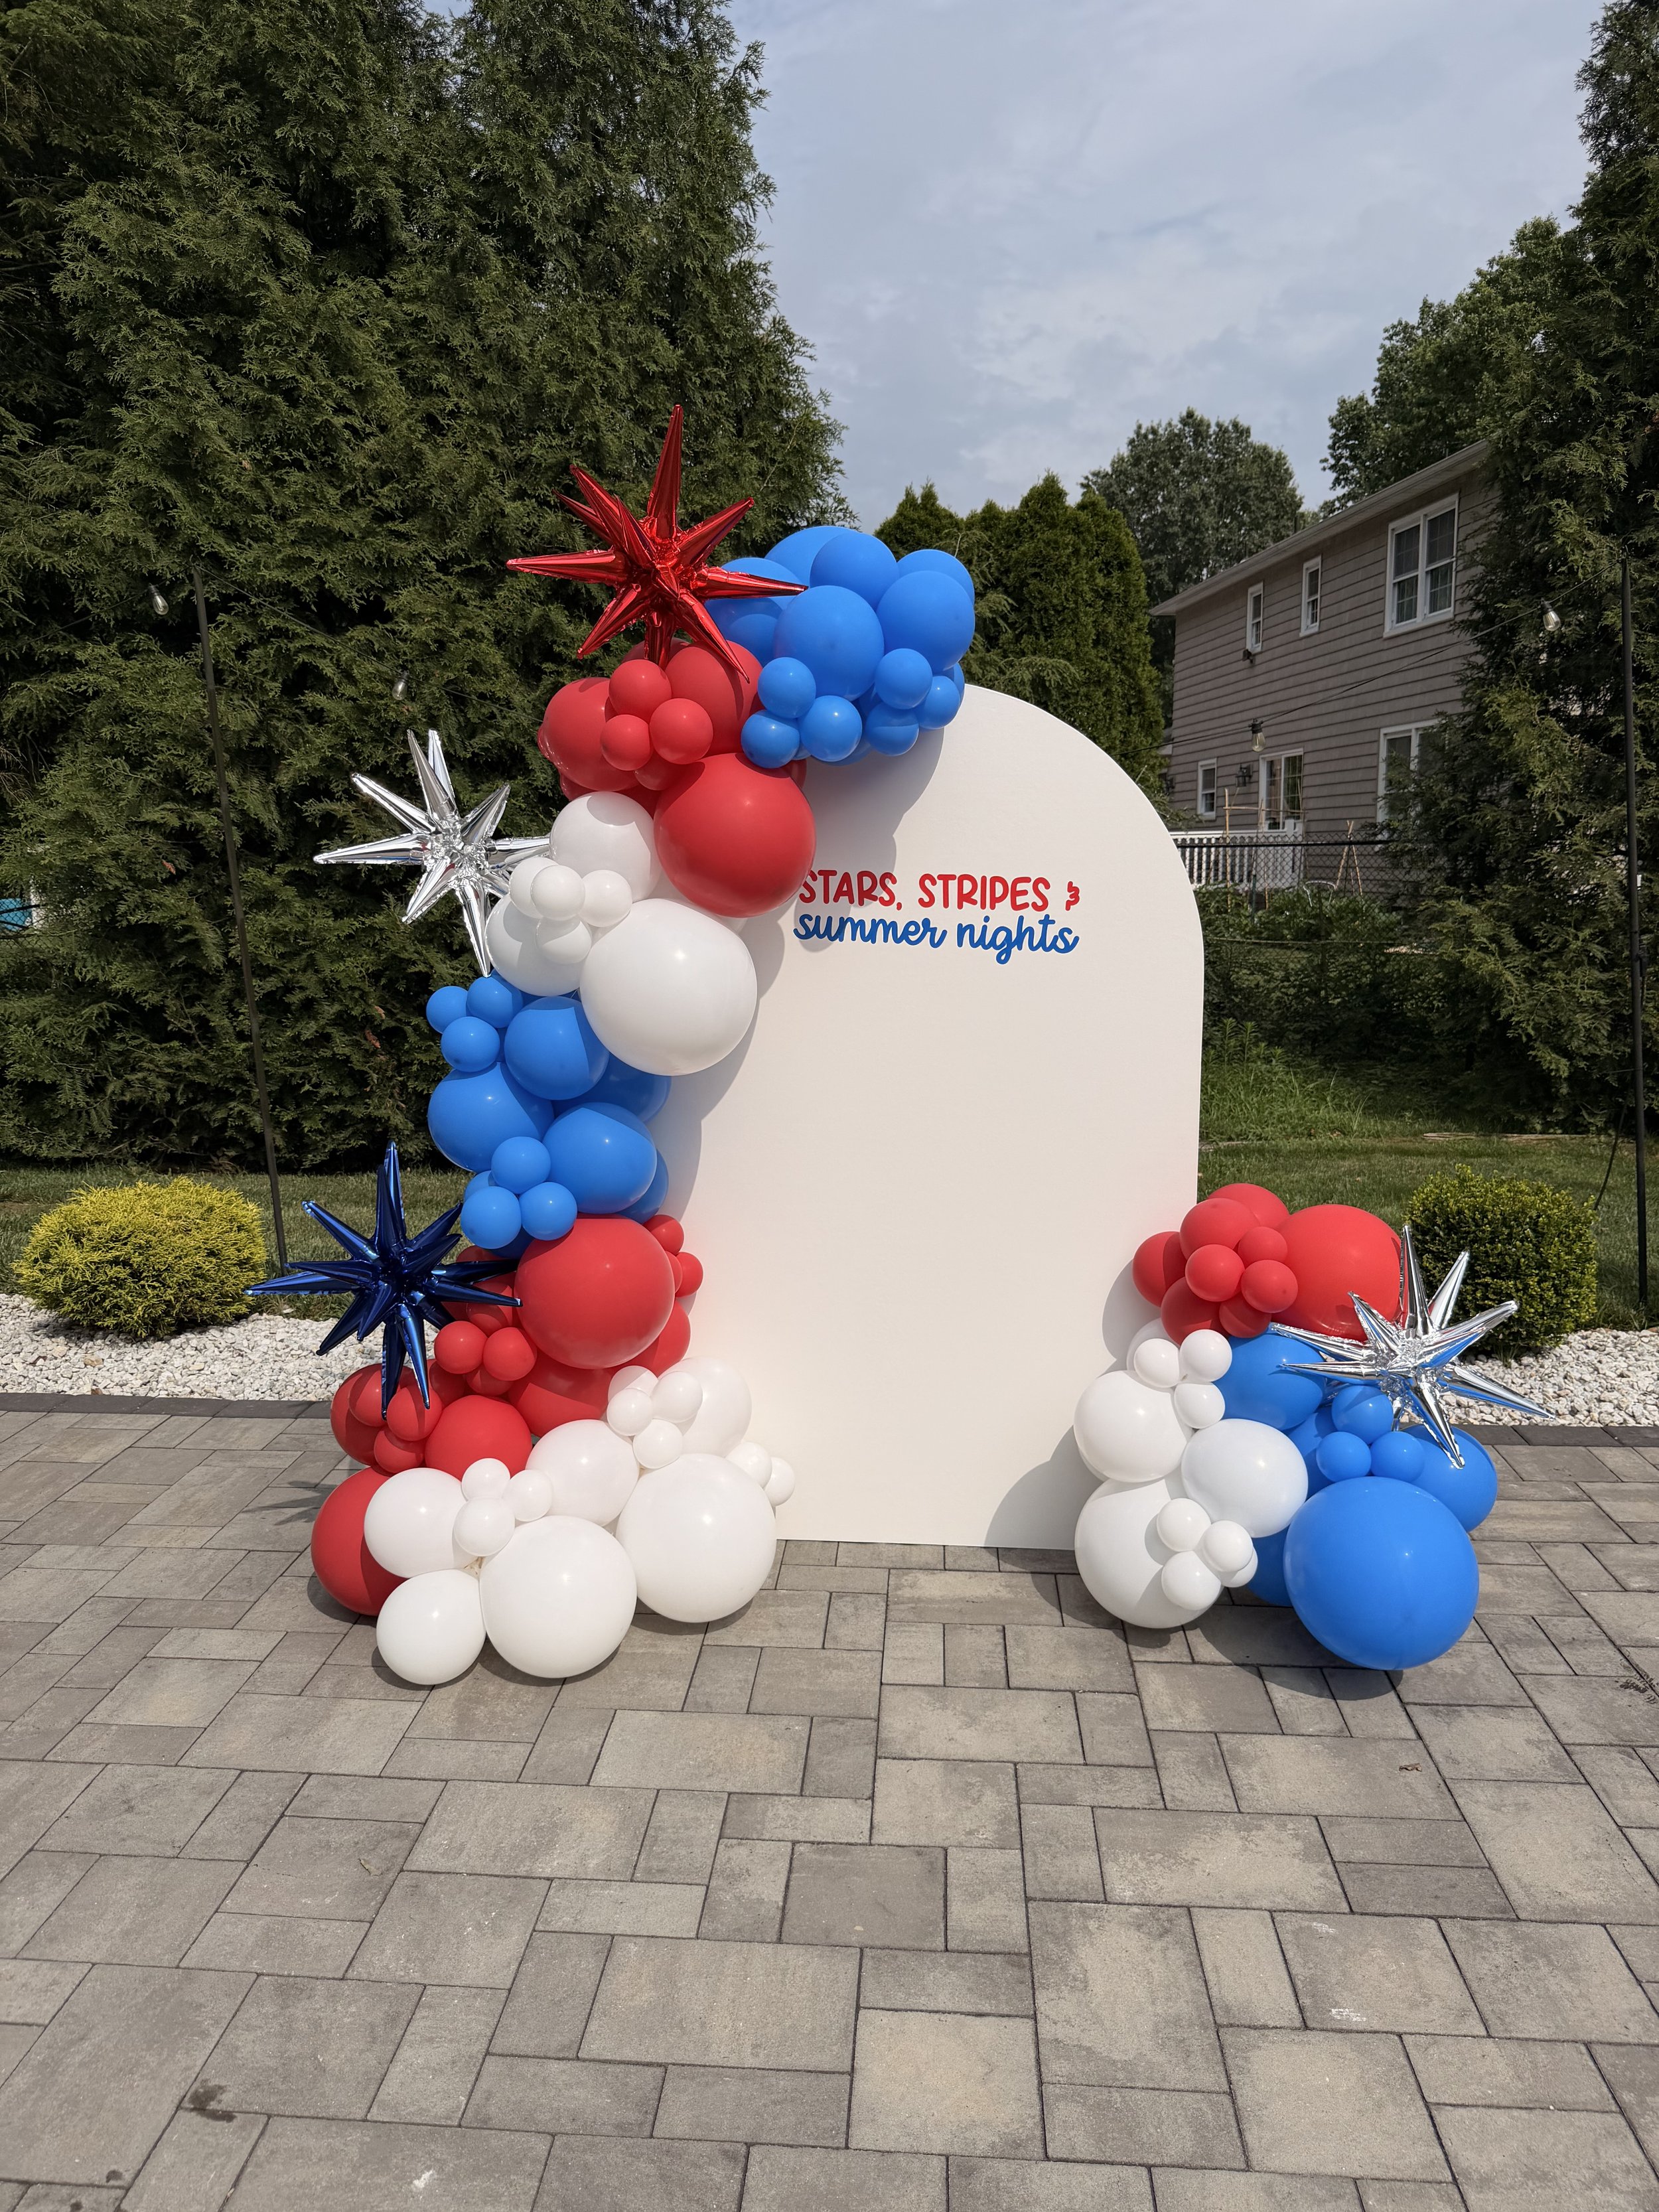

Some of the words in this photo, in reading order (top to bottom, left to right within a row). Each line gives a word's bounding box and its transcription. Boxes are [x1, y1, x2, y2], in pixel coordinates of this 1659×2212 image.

[798, 869, 902, 911] STARS,
[918, 873, 1050, 912] STRIPES
[793, 914, 948, 948] summer
[956, 914, 1080, 965] nights
